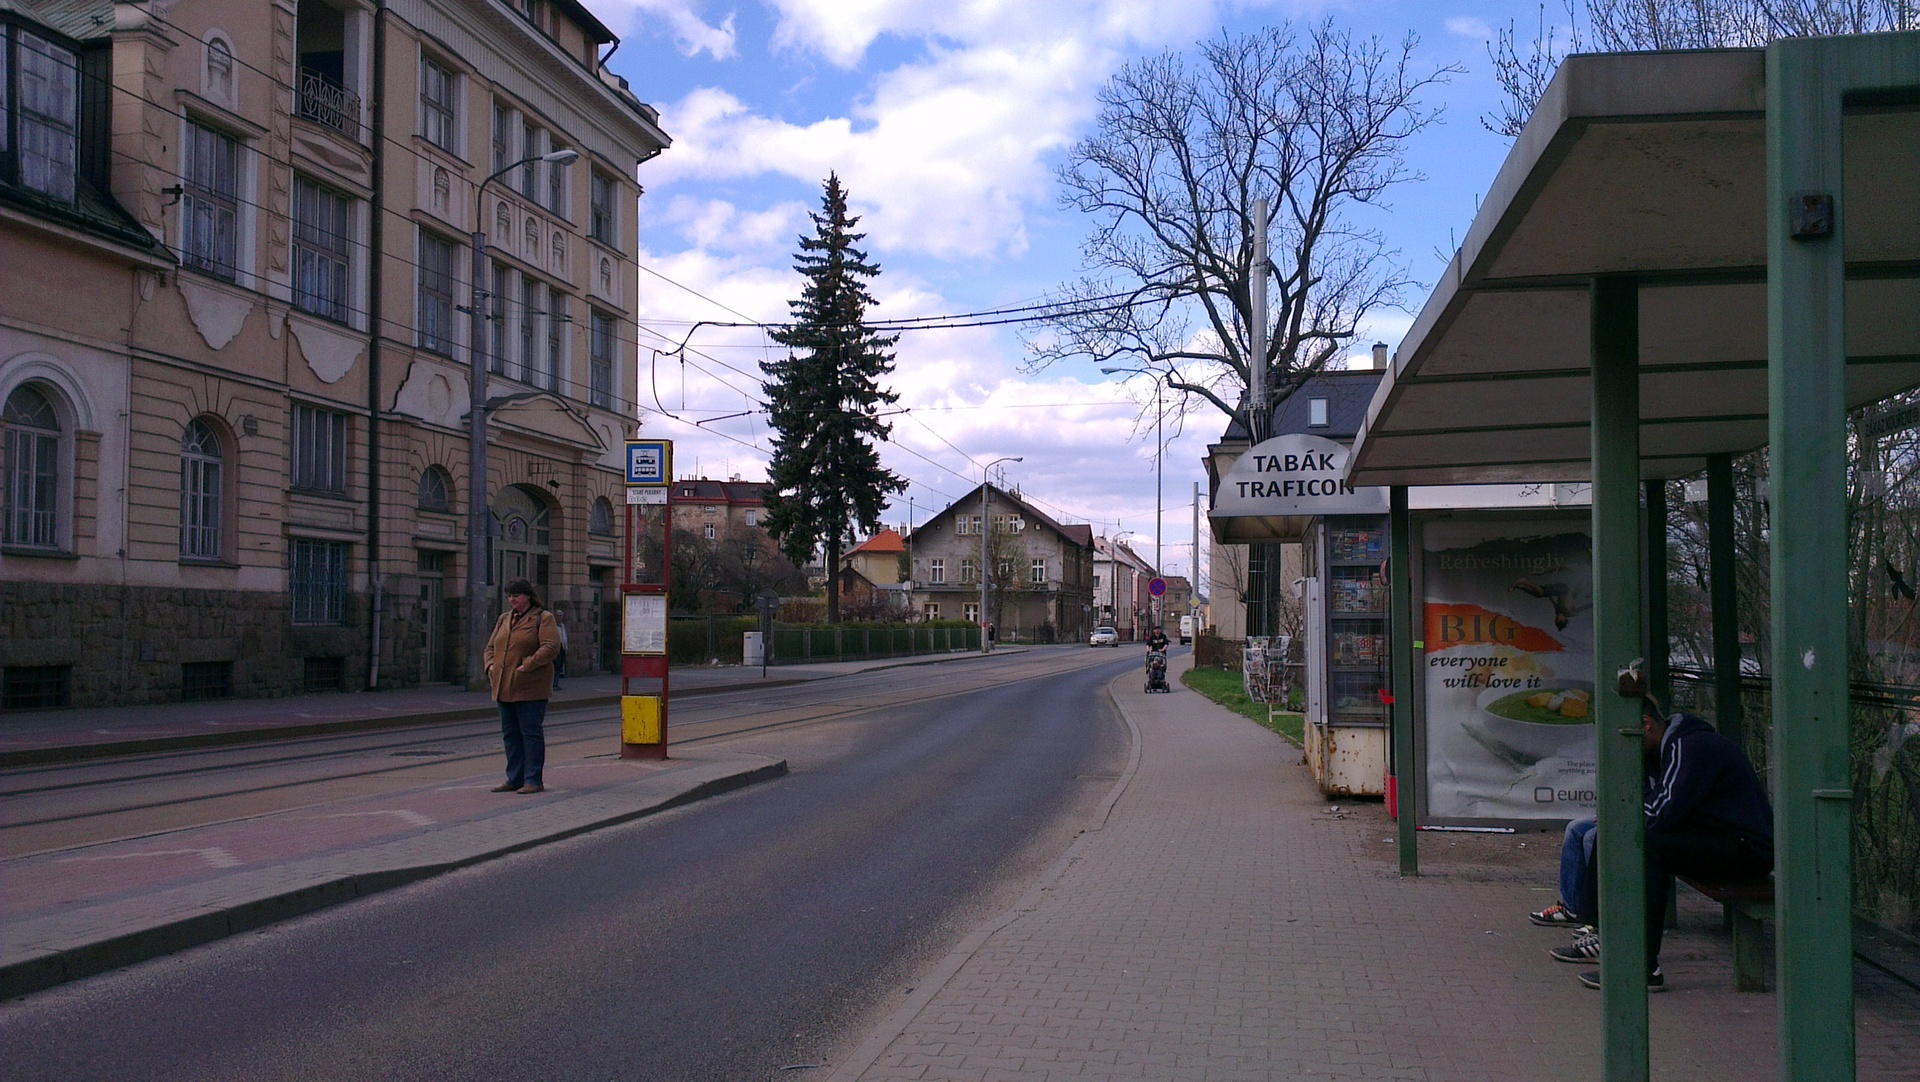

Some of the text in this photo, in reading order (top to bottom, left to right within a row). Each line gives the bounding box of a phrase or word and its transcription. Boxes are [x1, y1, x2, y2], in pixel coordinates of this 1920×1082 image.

[1253, 449, 1335, 473] TABÁK
[1440, 553, 1563, 574] Refreshingly
[1437, 614, 1517, 642] BIG
[1430, 656, 1508, 671] everyone
[1443, 673, 1541, 688] will love it
